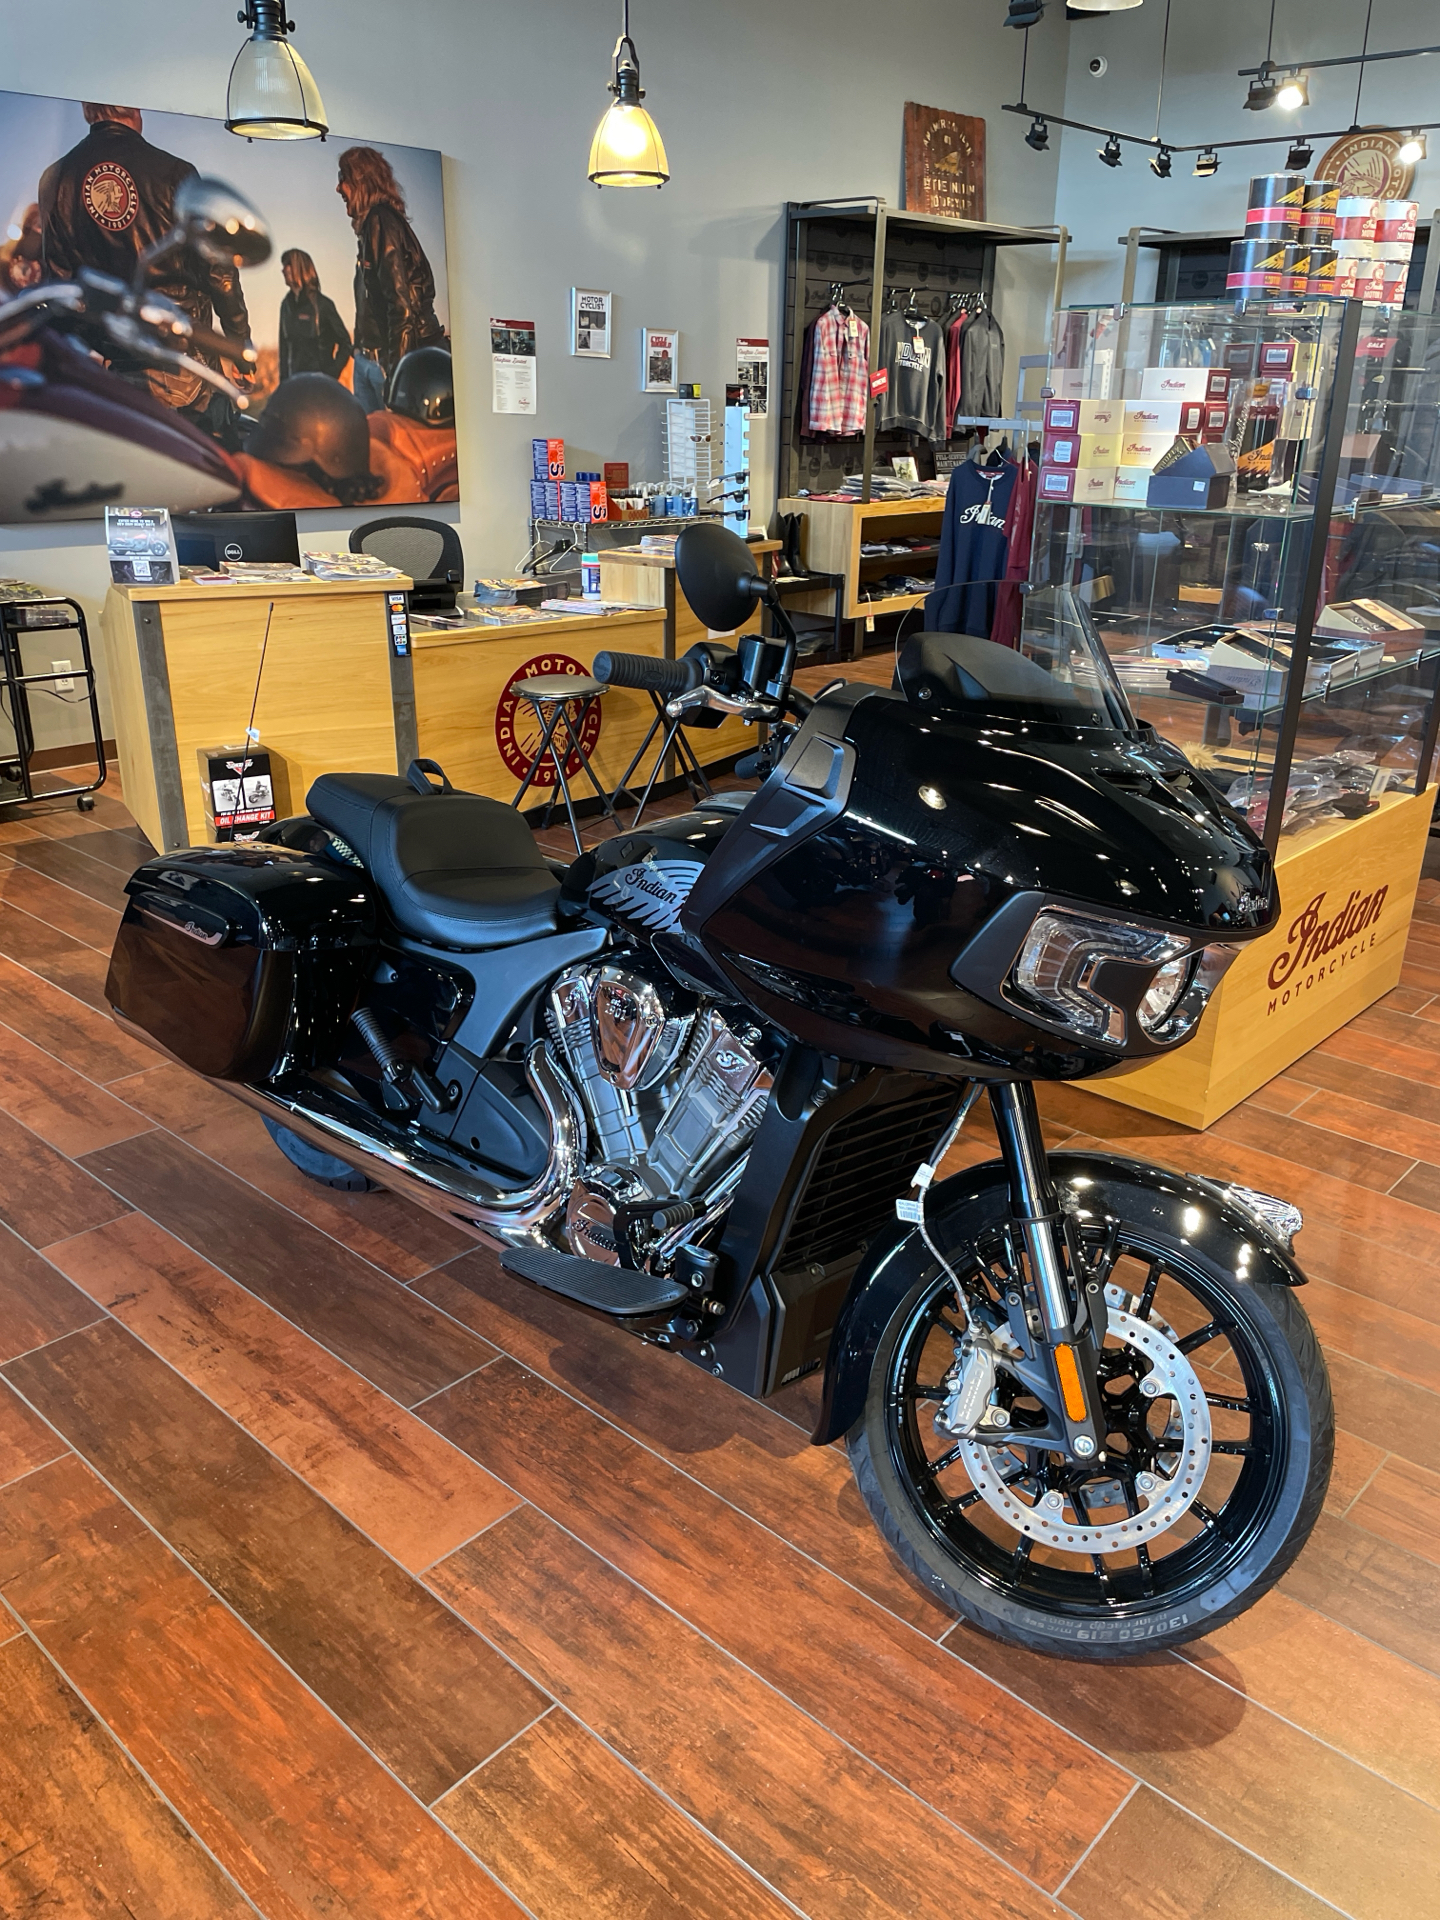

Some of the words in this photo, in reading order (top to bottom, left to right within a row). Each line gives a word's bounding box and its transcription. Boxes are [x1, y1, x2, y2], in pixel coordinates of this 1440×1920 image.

[1343, 140, 1394, 158] INDIAN
[85, 175, 99, 218] INDIAN
[95, 165, 137, 214] MOTORCYCLE
[108, 219, 126, 229] 1901
[580, 302, 604, 310] CYCLIST
[581, 296, 603, 304] MOTOR
[650, 335, 668, 343] CYCLE
[1161, 379, 1186, 388] Indian
[1133, 411, 1159, 420] Indian
[1126, 443, 1152, 452] Indian
[500, 699, 520, 766] INDIA
[525, 659, 598, 752] MOTOYCLE
[220, 817, 230, 825] OIL
[260, 811, 271, 819] KIT
[624, 867, 678, 904] Indian
[185, 921, 208, 940] Indian
[1267, 884, 1389, 990] Indian
[1267, 932, 1376, 1016] MOTORCYCLE
